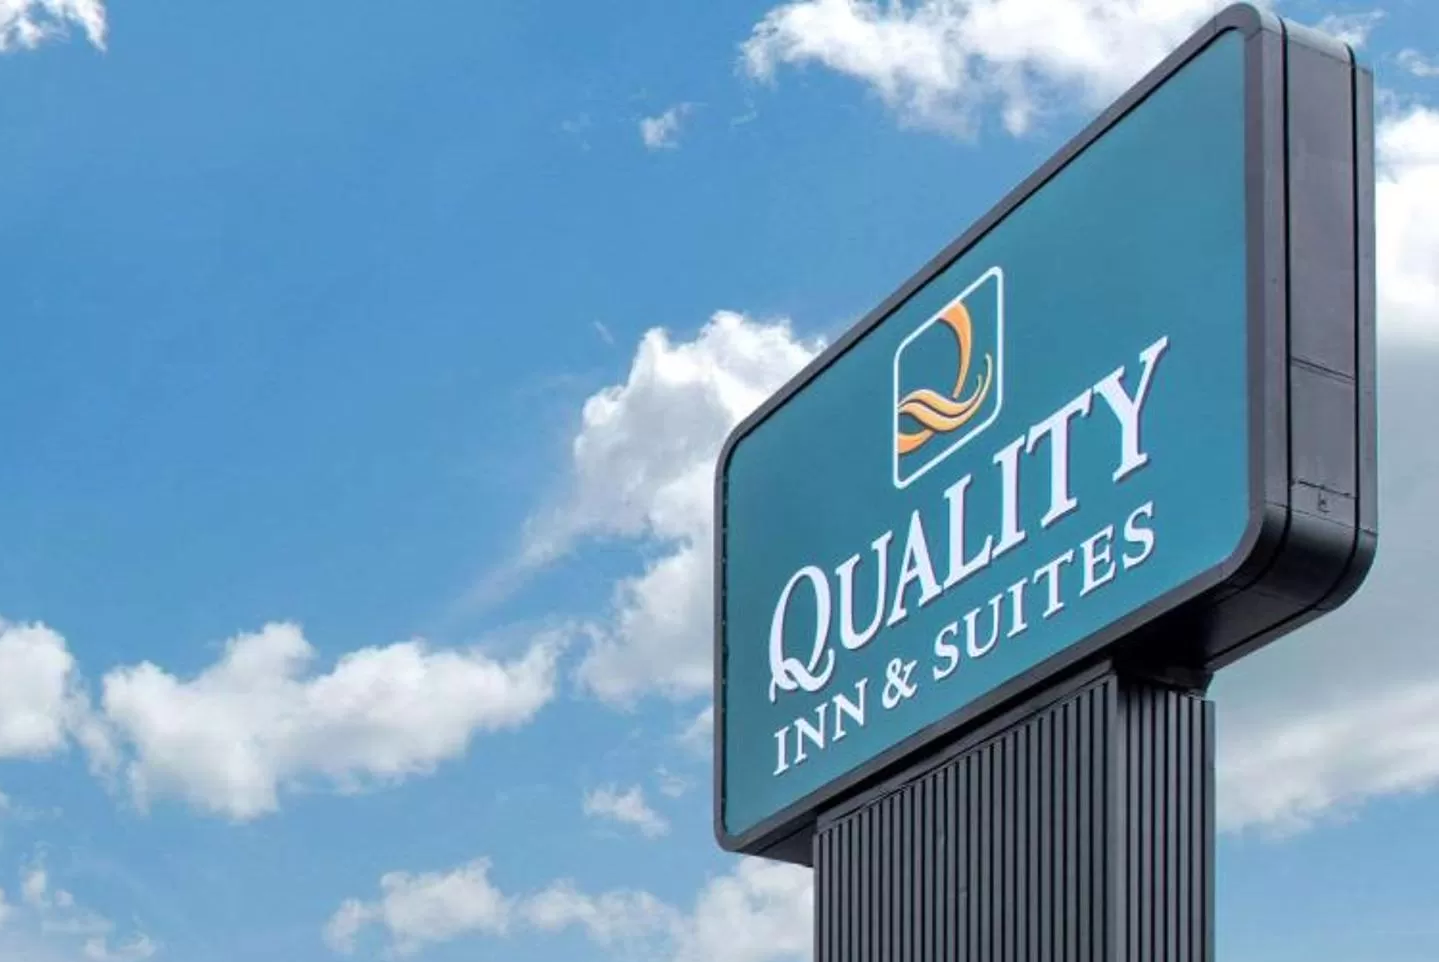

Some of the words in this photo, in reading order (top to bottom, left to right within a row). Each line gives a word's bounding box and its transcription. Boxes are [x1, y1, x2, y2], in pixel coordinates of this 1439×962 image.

[769, 335, 1169, 702] QUALITY
[773, 678, 869, 776] INN
[881, 658, 918, 710] &
[932, 502, 1156, 681] SUITES
